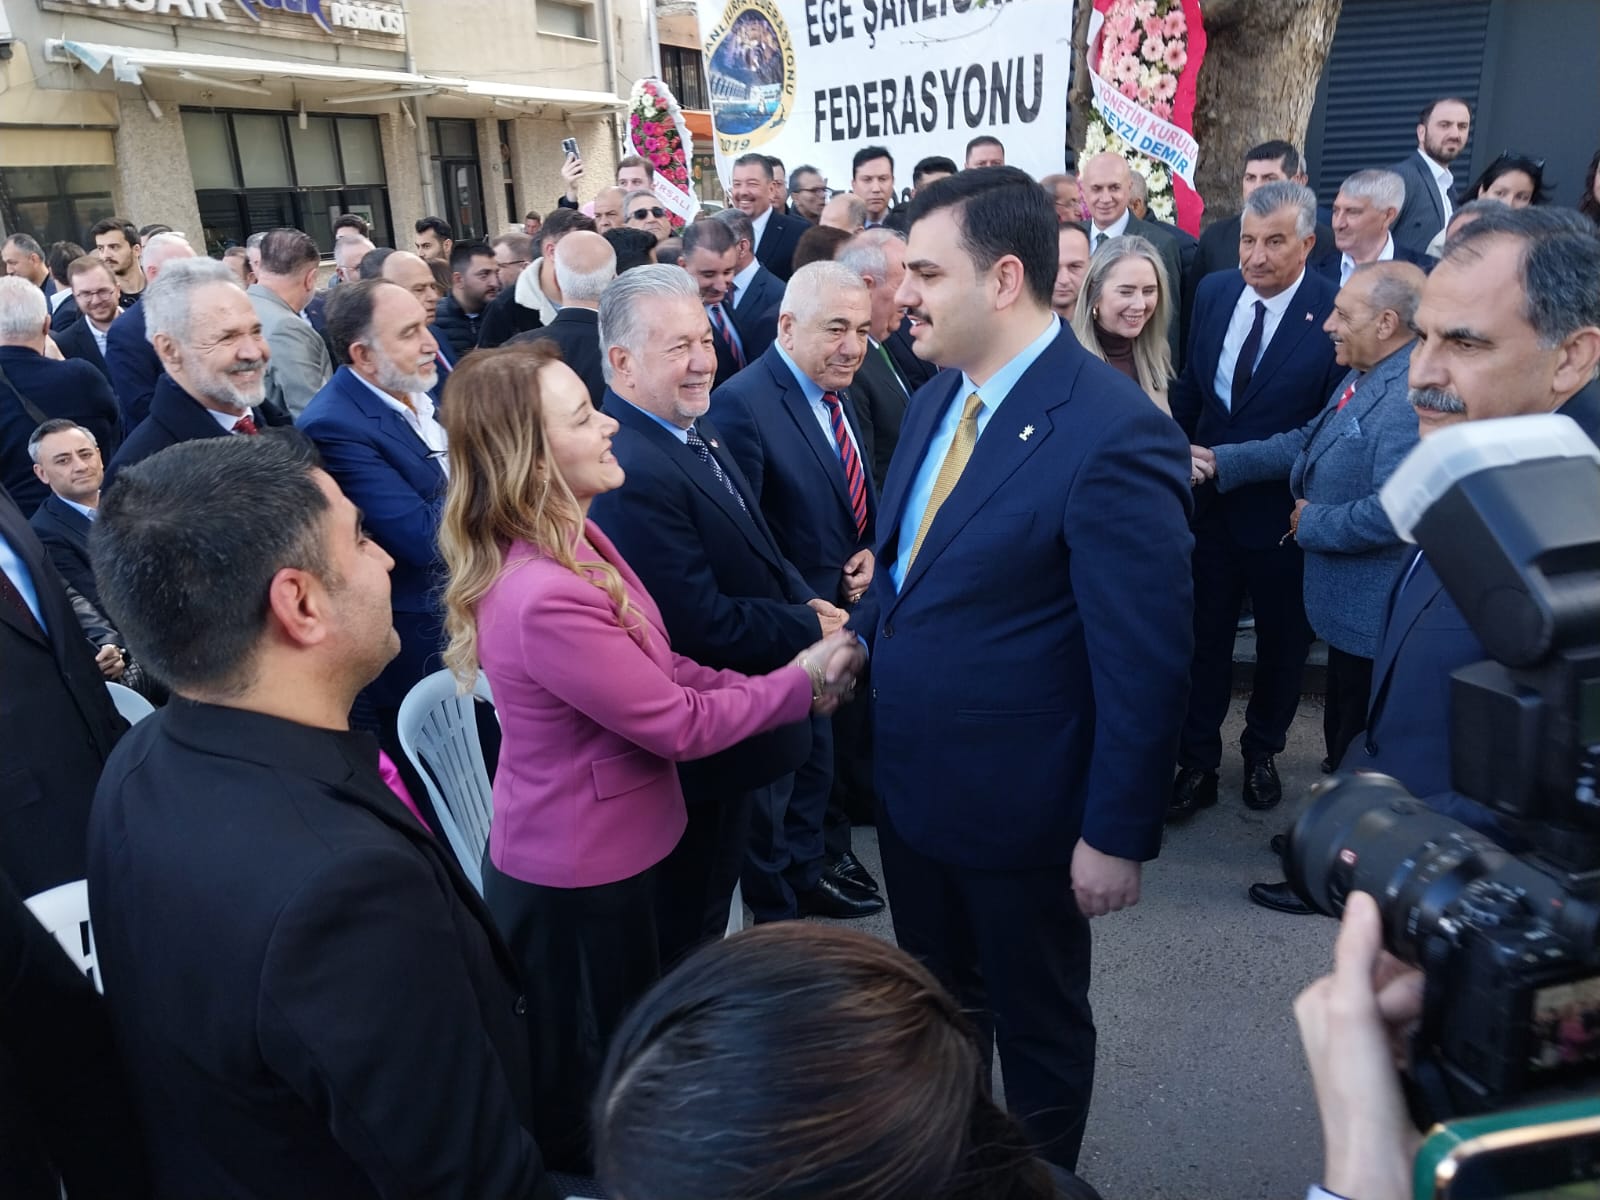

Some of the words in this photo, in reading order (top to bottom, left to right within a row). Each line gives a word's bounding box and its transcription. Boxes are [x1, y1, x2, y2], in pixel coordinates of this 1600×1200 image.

[805, 0, 854, 47] EGE
[814, 54, 1044, 143] FEDERASYONU
[1102, 106, 1140, 142] FEYZİ
[1140, 136, 1189, 174] DEMİR
[1148, 120, 1198, 160] KURULU
